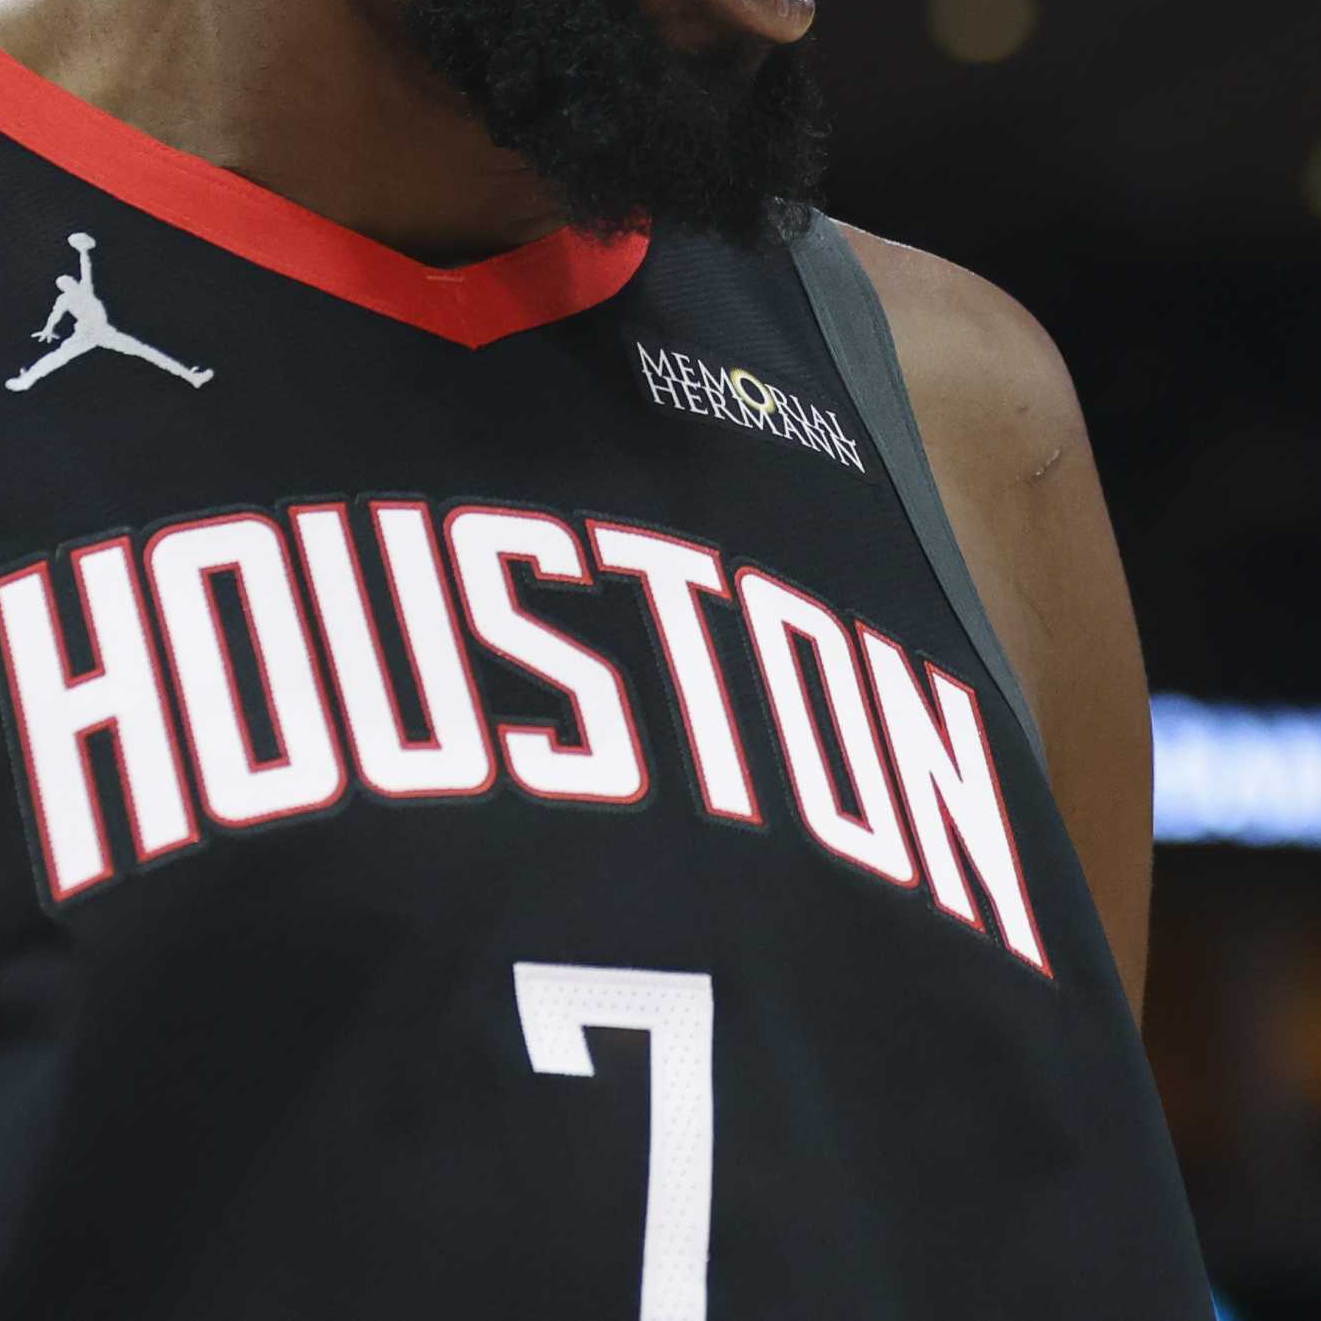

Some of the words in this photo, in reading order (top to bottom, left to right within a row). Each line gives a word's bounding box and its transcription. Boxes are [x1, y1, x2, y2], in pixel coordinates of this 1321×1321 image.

[637, 341, 856, 447] MEMORIAL
[643, 372, 866, 474] HERMANN
[513, 961, 713, 1321] 7
